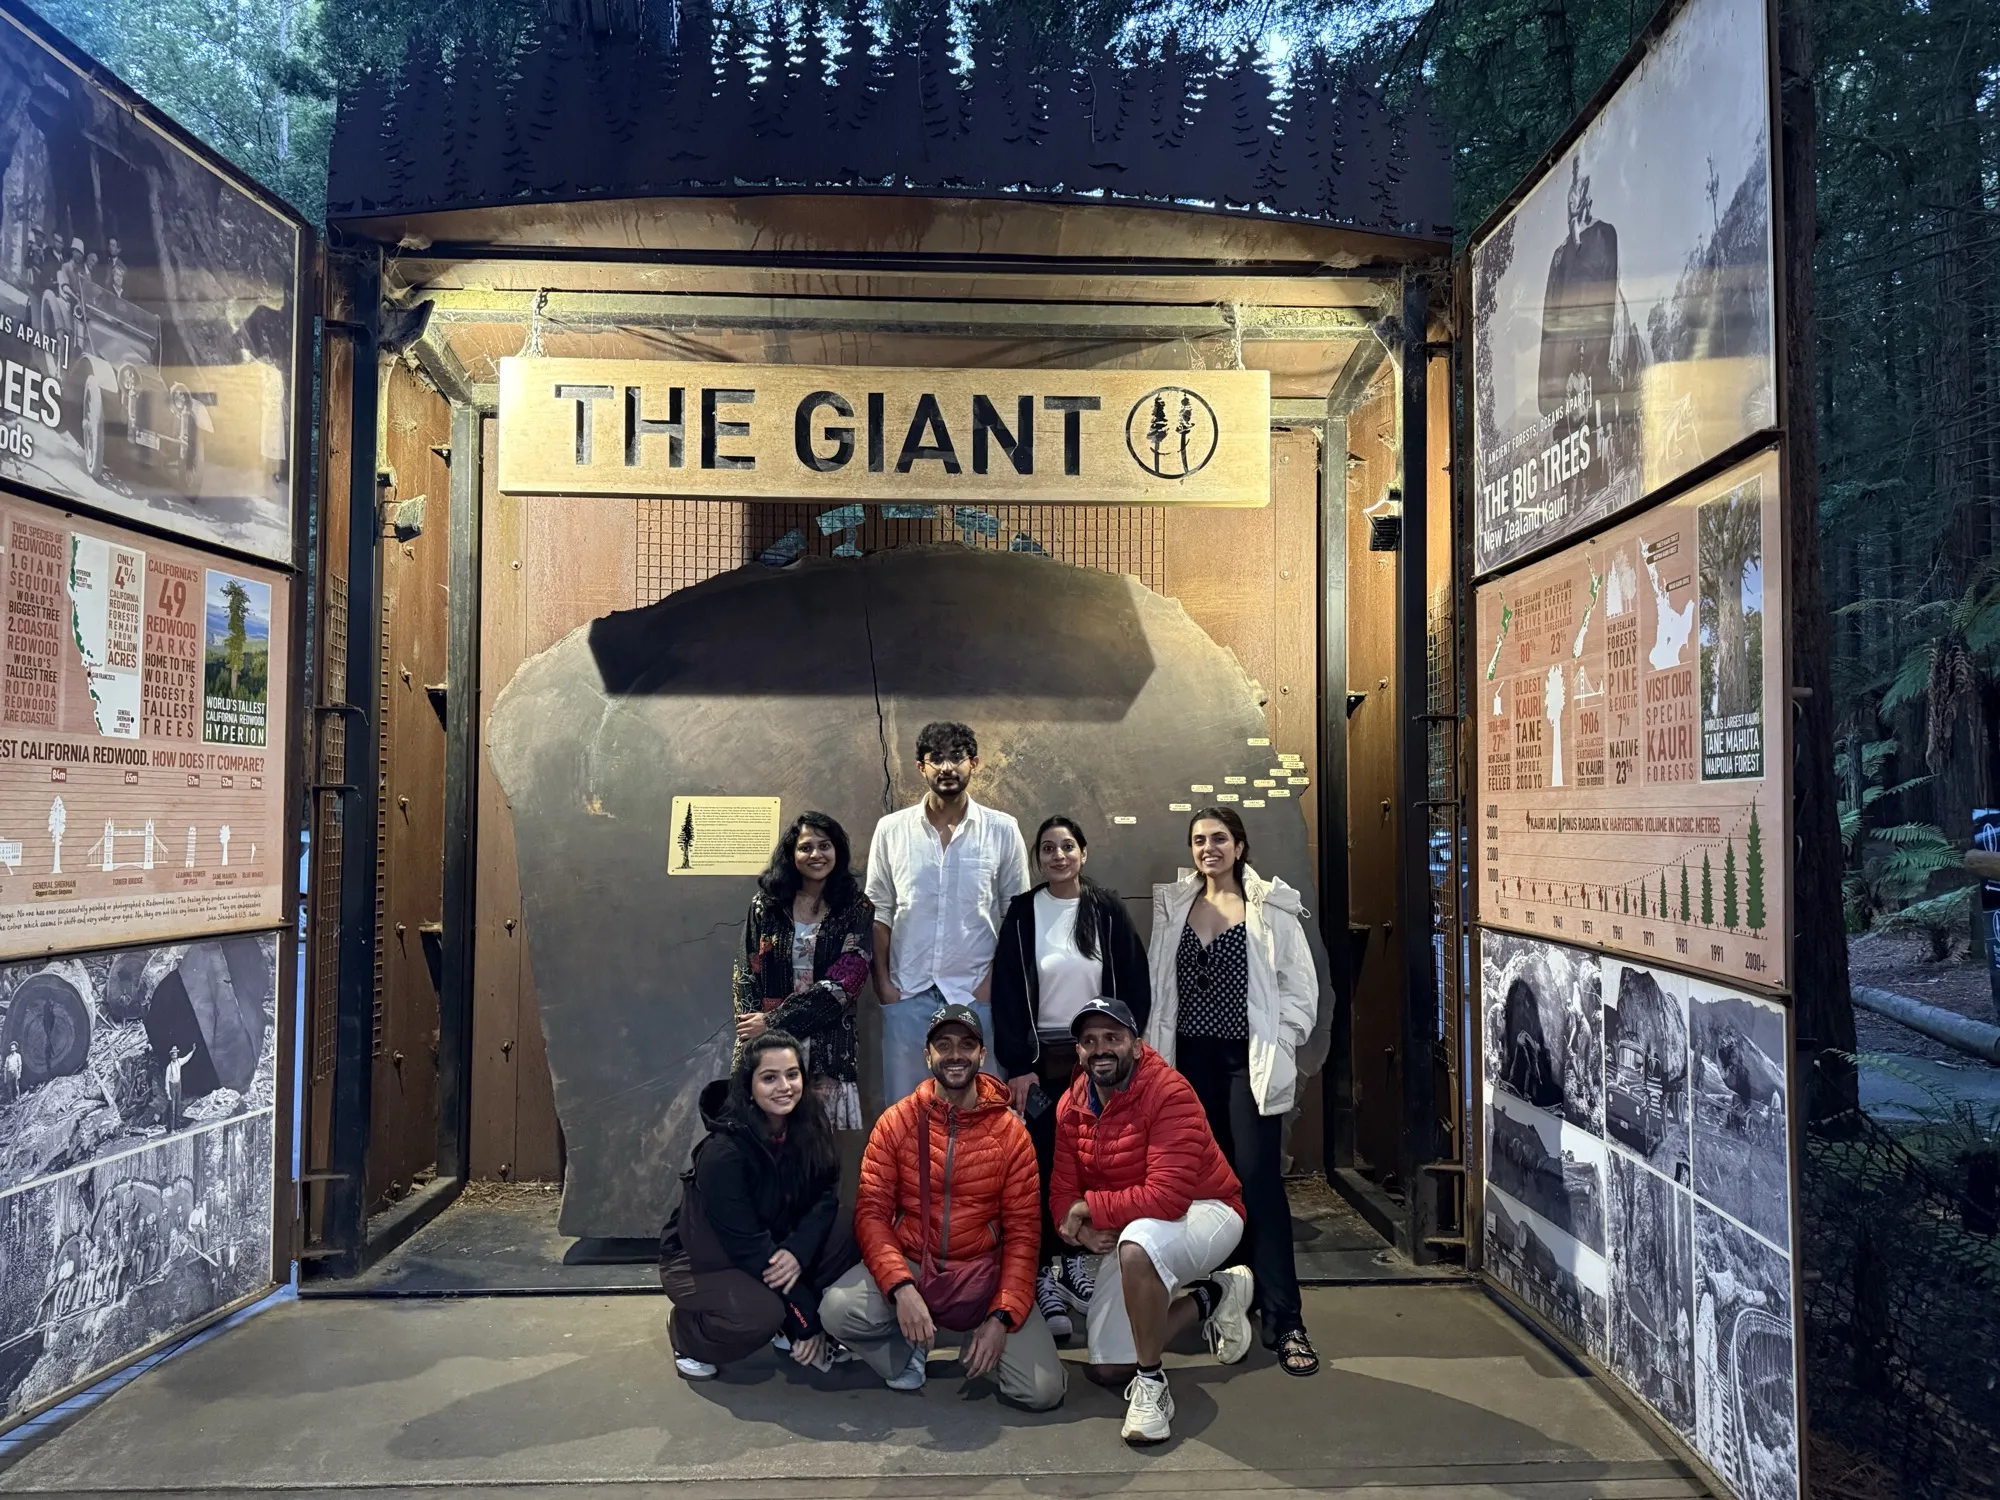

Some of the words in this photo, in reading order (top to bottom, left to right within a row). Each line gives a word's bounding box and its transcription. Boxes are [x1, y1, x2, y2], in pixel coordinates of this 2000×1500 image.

[17, 324, 57, 354] APART
[0, 359, 62, 428] EES
[555, 384, 755, 469] THE
[795, 391, 1102, 477] GIANT
[1488, 442, 1510, 465] ANCIENT
[1513, 425, 1538, 448] FORESTS,
[1540, 406, 1564, 431] OCEANS
[1566, 390, 1586, 414] APART
[1484, 474, 1509, 522] THE
[1513, 458, 1537, 508] BIG
[1541, 425, 1590, 491] TREES
[1484, 528, 1502, 553] New
[1505, 502, 1540, 543] Zealand
[1542, 489, 1567, 525] Kauri
[12, 522, 27, 535] TWO
[29, 526, 54, 542] SPECIES
[56, 533, 63, 543] OF
[12, 534, 62, 560] REDWOODS
[21, 556, 62, 579] GIANT
[117, 554, 134, 566] ONLY
[115, 566, 135, 589] 4%
[149, 560, 198, 582] CALIFORNIA'S
[10, 571, 60, 596] SEQUOIA
[17, 590, 53, 607] WORLD'S
[110, 590, 138, 602] CALIFORNIA
[158, 579, 186, 618] 49
[9, 601, 40, 619] BIGGEST
[42, 607, 60, 622] TREE
[110, 599, 138, 613] REDWOOD
[1545, 602, 1572, 622] NATIVE
[109, 610, 138, 623] FORESTS
[1515, 613, 1541, 632] NATIVE
[1608, 625, 1616, 634] NEW
[1617, 617, 1636, 631] ZEALAND
[109, 620, 138, 633] REMAIN
[147, 615, 196, 639] REDWOOD
[8, 635, 58, 657] REDWOOD
[108, 639, 112, 649] 2
[113, 640, 137, 653] MILLION
[115, 631, 132, 642] FROM
[146, 634, 196, 657] PARKS
[1608, 630, 1636, 650] FORESTS
[14, 654, 51, 668] WORLD'S
[108, 652, 136, 668] ACRES
[145, 653, 167, 670] HOME
[170, 657, 179, 670] TO
[182, 659, 195, 673] THE
[1608, 648, 1637, 669] TODAY
[7, 665, 36, 680] TALLEST
[38, 670, 57, 683] TREE
[145, 669, 195, 688] WORLD'S
[1609, 669, 1637, 695] PINE
[6, 680, 56, 699] ROTORUA
[144, 684, 185, 701] BIGGEST
[189, 690, 194, 702] &
[1516, 677, 1541, 696] OLDEST
[1646, 675, 1670, 703] VISIT
[1672, 670, 1692, 697] OUR
[5, 696, 56, 712] REDWOODS
[144, 700, 194, 719] TALLEST
[207, 696, 236, 711] WORLD'S
[238, 700, 265, 714] TALLEST
[1516, 696, 1541, 719] KAURI
[1615, 692, 1638, 711] EXOTIC
[4, 709, 18, 721] ARE
[20, 710, 55, 725] COASTAL!
[206, 712, 237, 723] CALIFORNIA
[240, 714, 264, 726] REDWOOD
[1581, 712, 1599, 734] 1906
[1646, 702, 1692, 726] SPECIAL
[1724, 714, 1744, 729] LARGEST
[1745, 712, 1759, 725] KAURI
[143, 718, 193, 737] TREES
[206, 726, 264, 744] HYPERION
[1516, 720, 1541, 743] TANE
[1609, 740, 1638, 759] NATIVE
[1647, 724, 1693, 762] KAURI
[1705, 733, 1724, 754] TANE
[1726, 728, 1759, 751] MAHUTA
[21, 742, 90, 763] CALIFORNIA
[93, 747, 149, 766] REDWOOD.
[152, 751, 176, 768] HOW
[179, 753, 204, 769] DOES
[207, 755, 215, 769] IT
[217, 756, 264, 772] COMPARE?
[1516, 745, 1541, 759] MAHUTA
[1488, 764, 1510, 776] FORESTS
[1586, 760, 1603, 775] KAURI
[1647, 762, 1694, 782] FORESTS
[1705, 757, 1733, 775] WAIPOUA
[1735, 754, 1759, 773] FOREST
[52, 770, 65, 780] 84m
[126, 773, 137, 783] 65m
[1489, 777, 1510, 791] FELLED
[1534, 774, 1542, 788] YO
[1531, 818, 1545, 831] KAURI
[1546, 818, 1557, 831] AND
[1563, 818, 1577, 832] PINUS
[1578, 818, 1600, 832] RADIATA
[1610, 818, 1642, 832] HARVESTING
[1644, 818, 1667, 832] VOLUME
[1669, 818, 1674, 832] IN
[1676, 818, 1694, 833] CUBIC
[1696, 817, 1720, 834] METRES
[33, 881, 52, 889] GENERAL
[1582, 920, 1592, 934] 1951
[1644, 931, 1654, 946] 1971
[1711, 944, 1724, 962] 1991
[1746, 952, 1767, 972] 2000+
